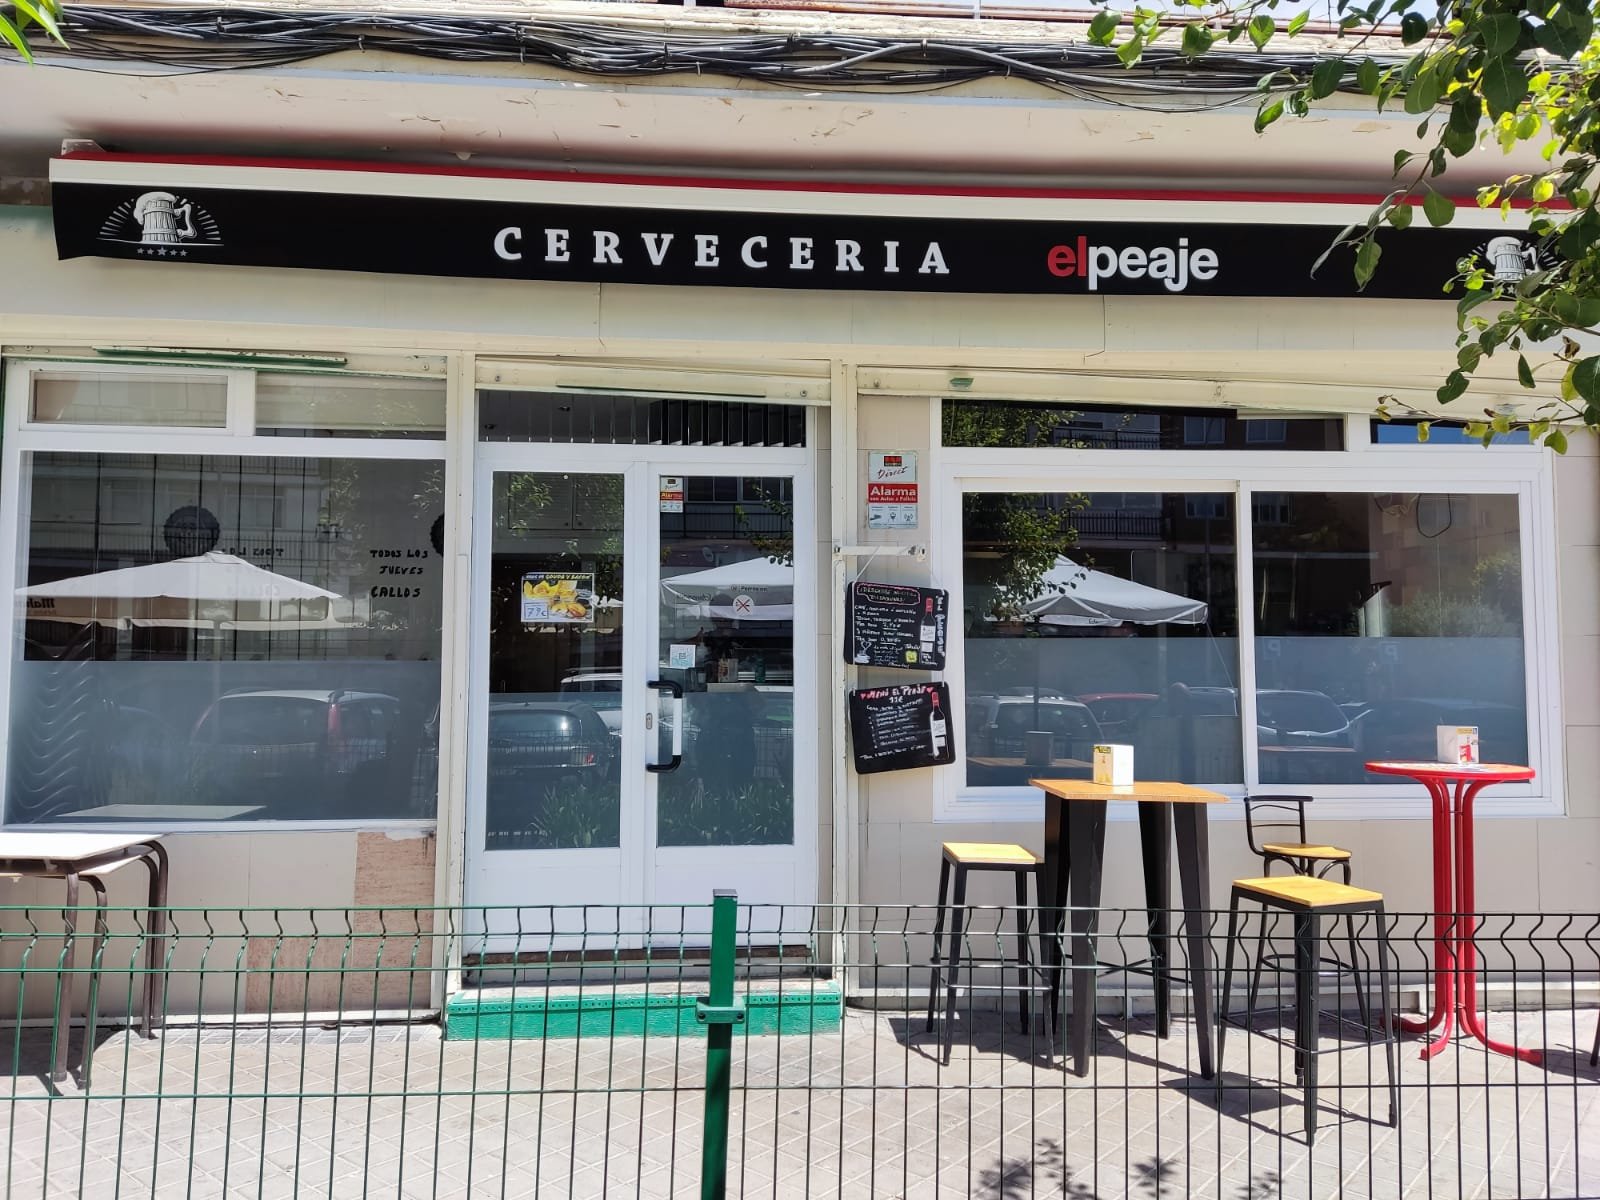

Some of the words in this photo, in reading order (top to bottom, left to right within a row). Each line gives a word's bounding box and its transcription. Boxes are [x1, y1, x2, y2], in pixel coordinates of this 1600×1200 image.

[493, 226, 950, 275] CERVECERIA
[870, 486, 917, 496] Alarma
[370, 549, 402, 558] TODOS
[407, 549, 428, 559] LOS
[379, 565, 424, 575] JUEVES
[371, 585, 421, 598] CALLOS
